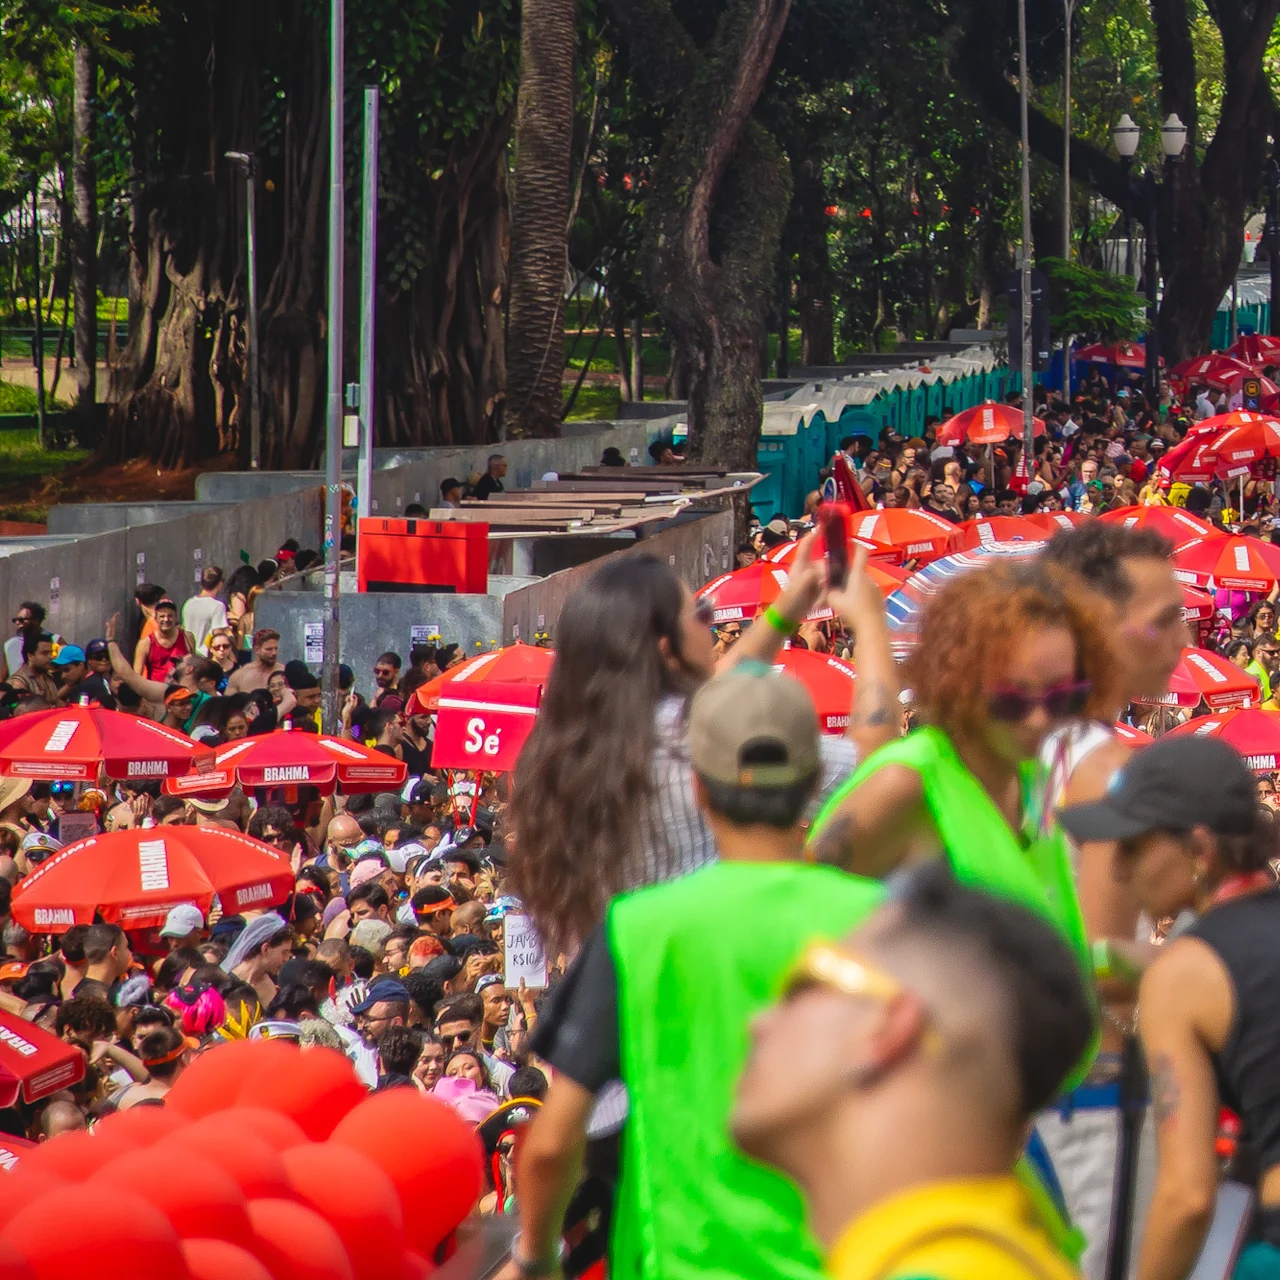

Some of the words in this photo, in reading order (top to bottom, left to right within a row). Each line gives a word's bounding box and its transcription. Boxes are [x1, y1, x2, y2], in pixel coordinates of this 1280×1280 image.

[465, 717, 502, 755] Sé
[127, 761, 169, 776] BRAHMA
[264, 766, 310, 782] BRAHMA
[236, 883, 274, 905] BRAHMA
[34, 908, 75, 925] BRAHMA
